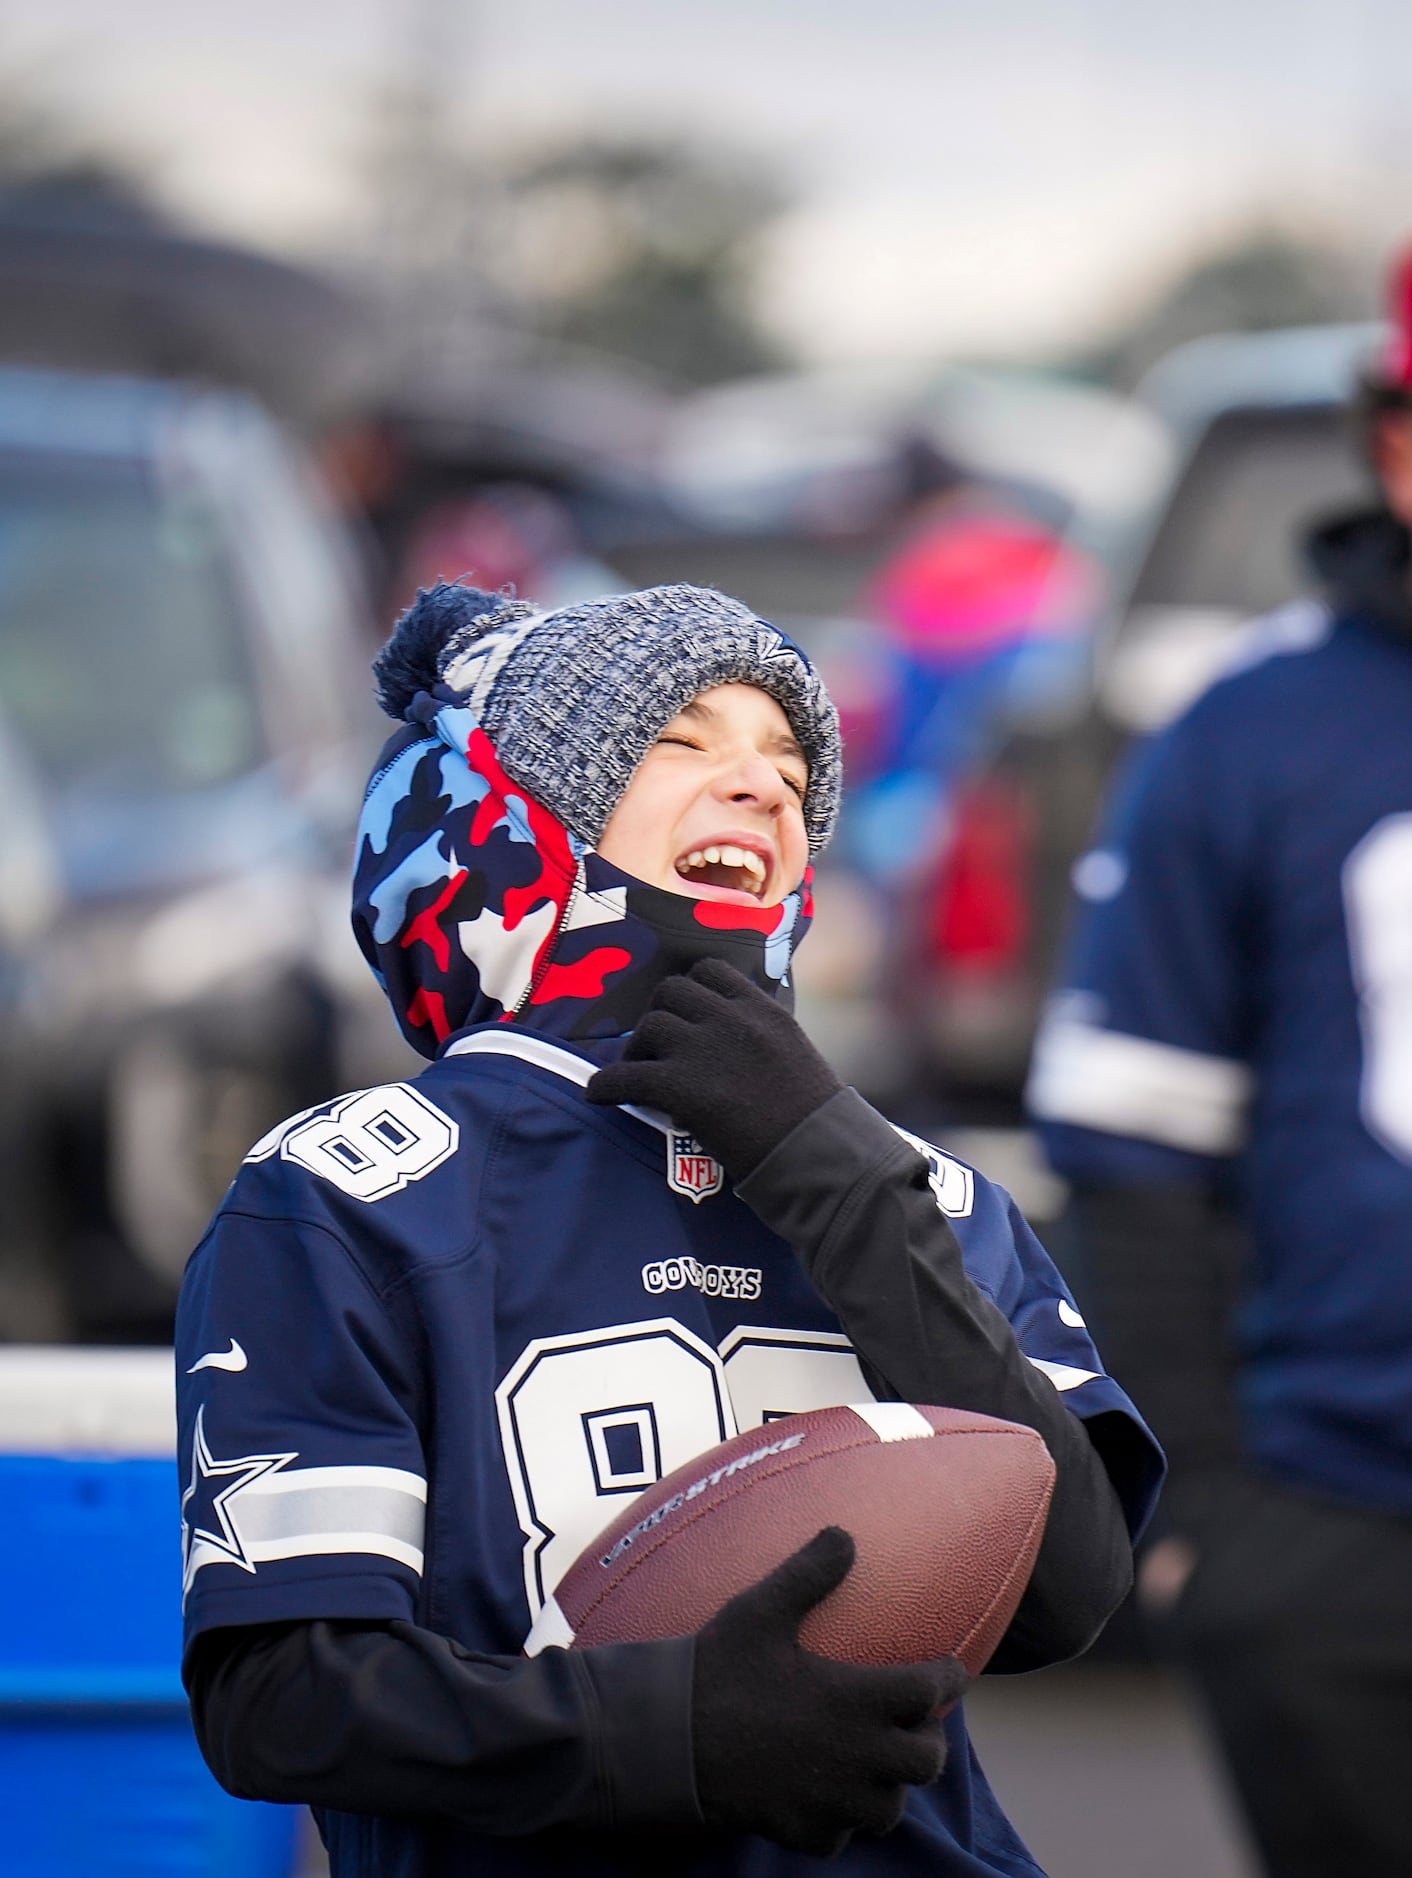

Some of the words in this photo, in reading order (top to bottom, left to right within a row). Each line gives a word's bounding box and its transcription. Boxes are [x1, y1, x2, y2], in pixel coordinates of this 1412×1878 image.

[678, 1157, 717, 1188] NFL
[641, 1256, 763, 1300] COOYS
[685, 1432, 806, 1500] STRIKE
